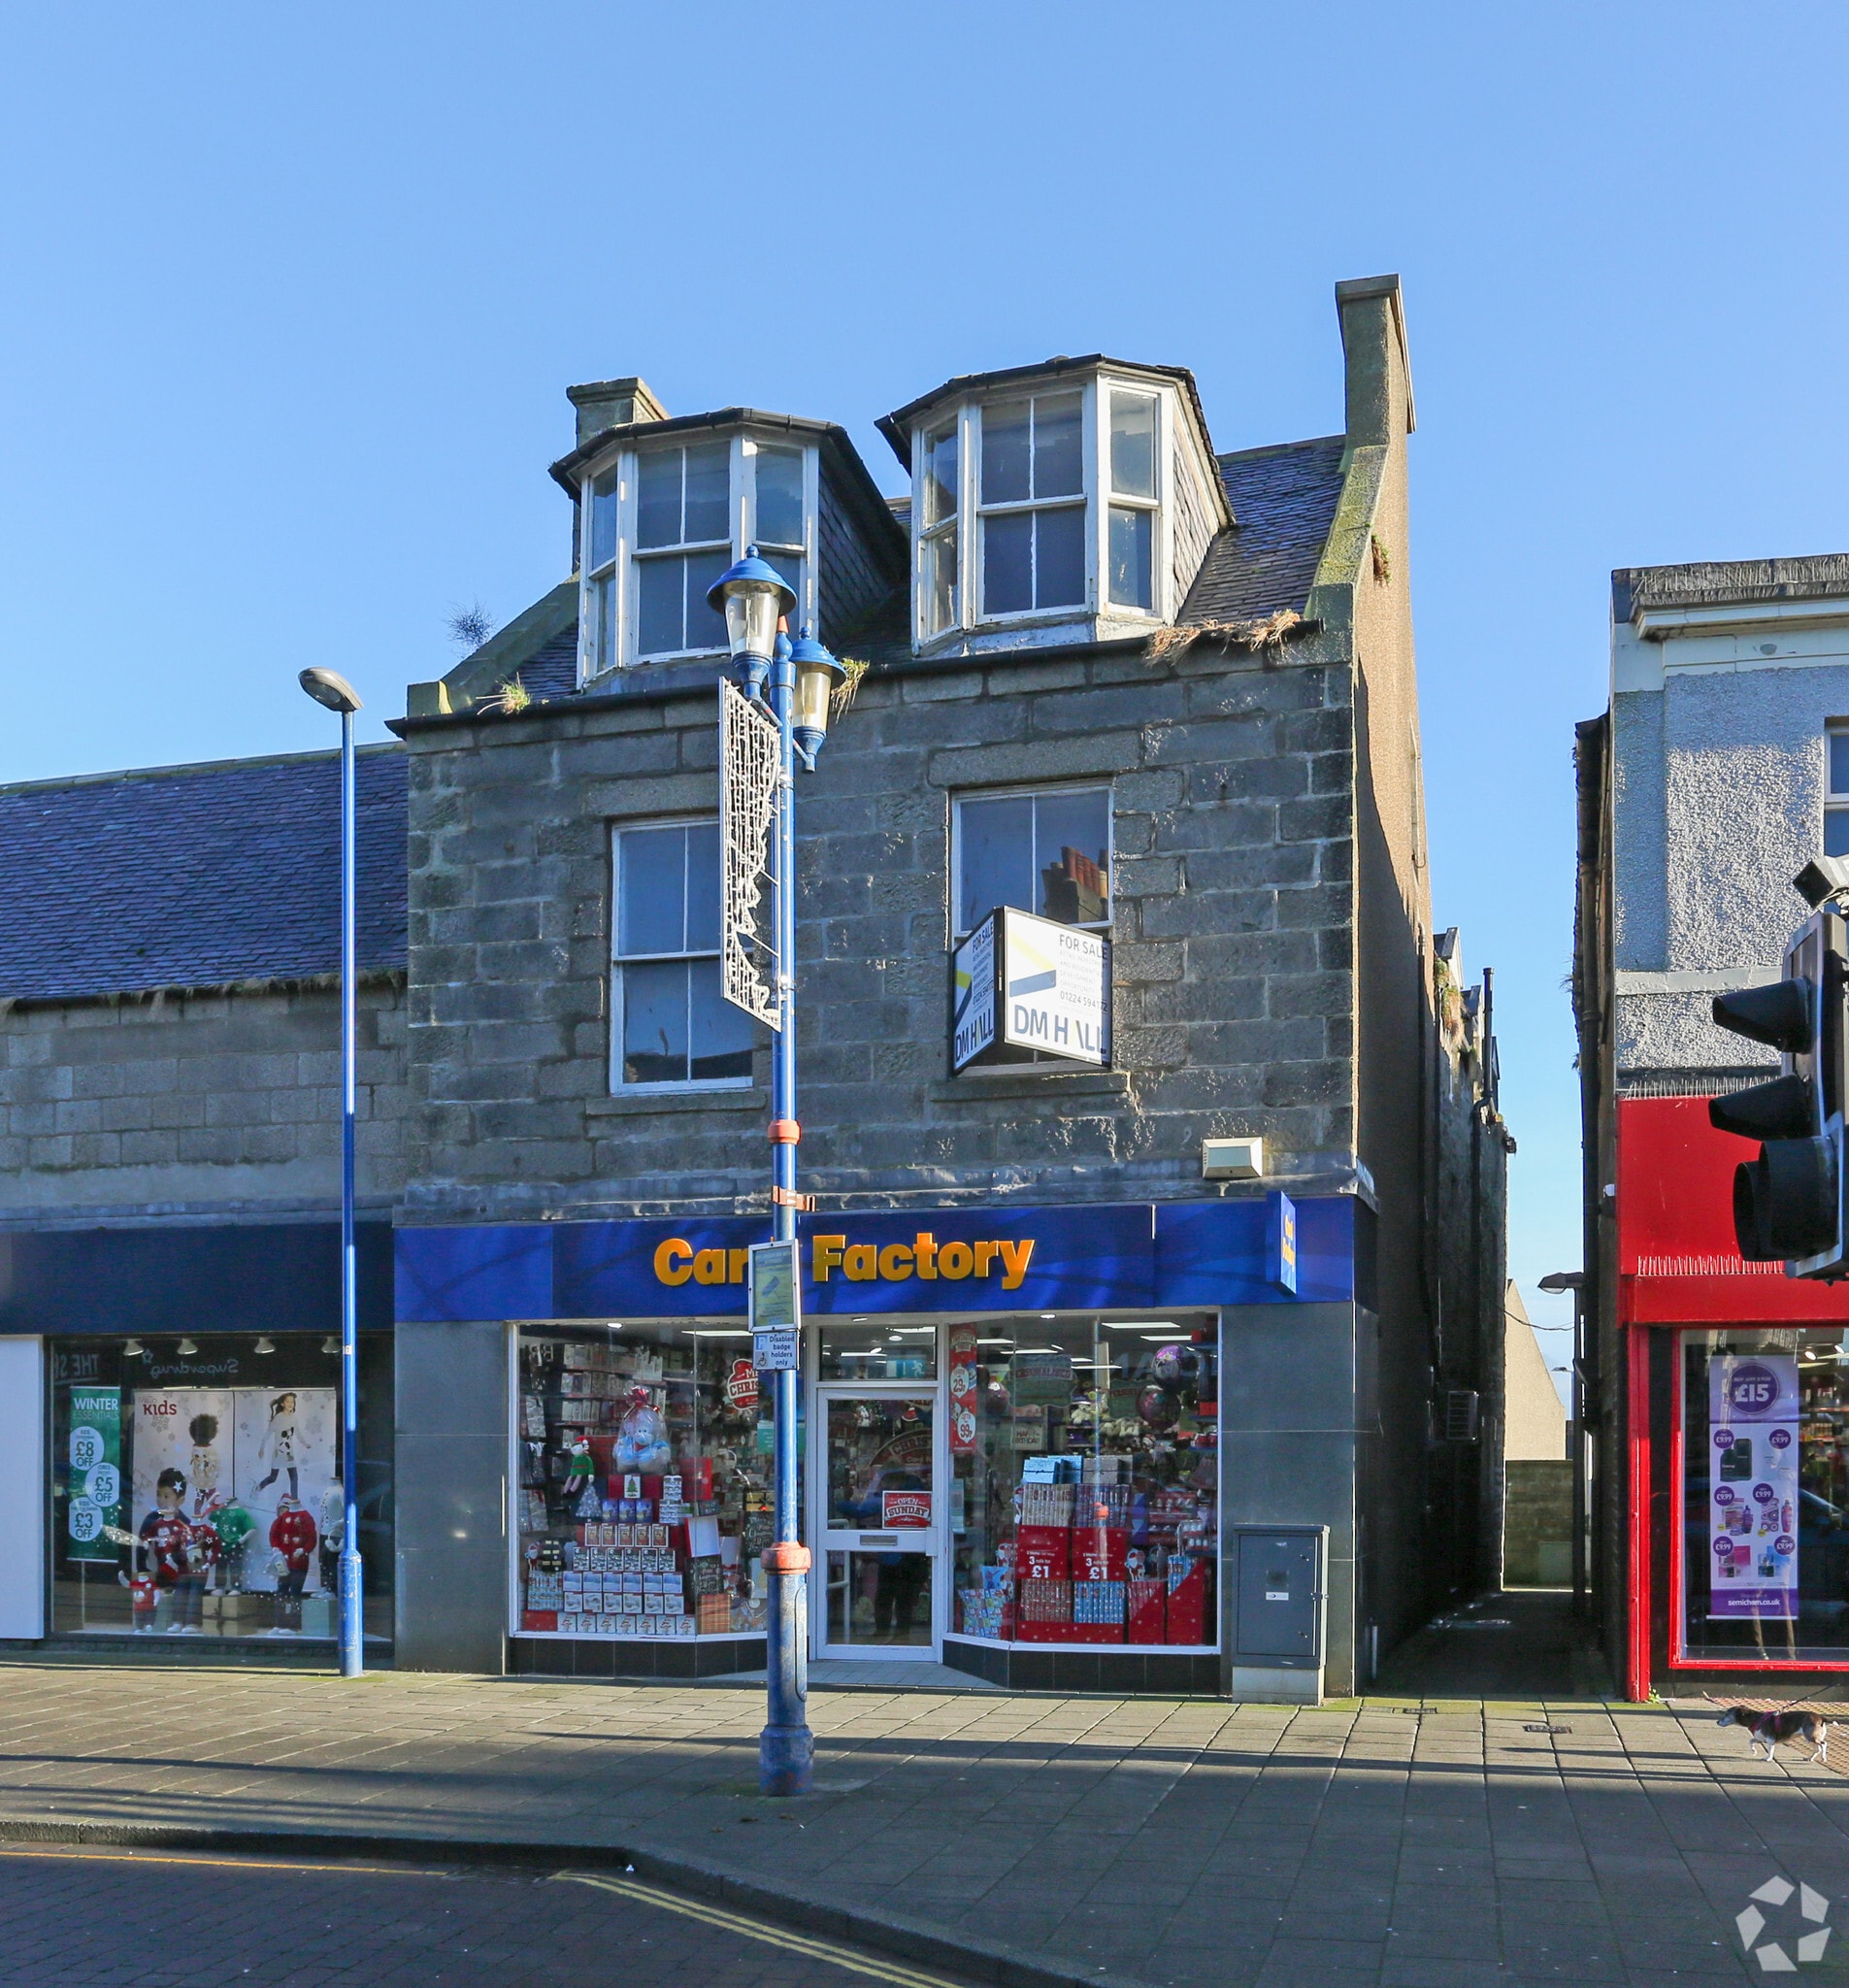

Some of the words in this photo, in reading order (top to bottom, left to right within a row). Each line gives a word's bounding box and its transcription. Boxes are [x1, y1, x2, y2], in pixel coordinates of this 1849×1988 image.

[973, 935, 981, 952] FOR
[982, 922, 994, 944] SALE
[1060, 935, 1079, 951] FOR
[1082, 942, 1108, 960] SALE
[1060, 989, 1081, 1004] 01224
[1014, 1004, 1048, 1040] DM
[1054, 1014, 1106, 1055] HALL
[955, 1025, 969, 1062] DM
[654, 1238, 749, 1286] Car
[811, 1232, 1036, 1290] Factory
[770, 1334, 795, 1342] Disabled
[773, 1342, 791, 1351] badge
[1735, 1383, 1769, 1403] £15
[74, 1398, 118, 1410] WINTER
[143, 1400, 177, 1416] kids
[73, 1410, 119, 1420] ESSENTIALS
[76, 1441, 94, 1456] £8
[77, 1457, 93, 1467] OFF
[94, 1476, 114, 1492] £5
[96, 1492, 113, 1503] OFF
[898, 1497, 918, 1506] OPEN
[888, 1506, 927, 1517] SUNDAY
[75, 1512, 93, 1528] £3
[76, 1529, 92, 1539] OFF
[1029, 1556, 1035, 1565] 3
[1085, 1558, 1092, 1567] 3
[1032, 1565, 1049, 1578] £1
[1089, 1567, 1107, 1579] £1
[1728, 1598, 1780, 1607] semichem.co.uk
